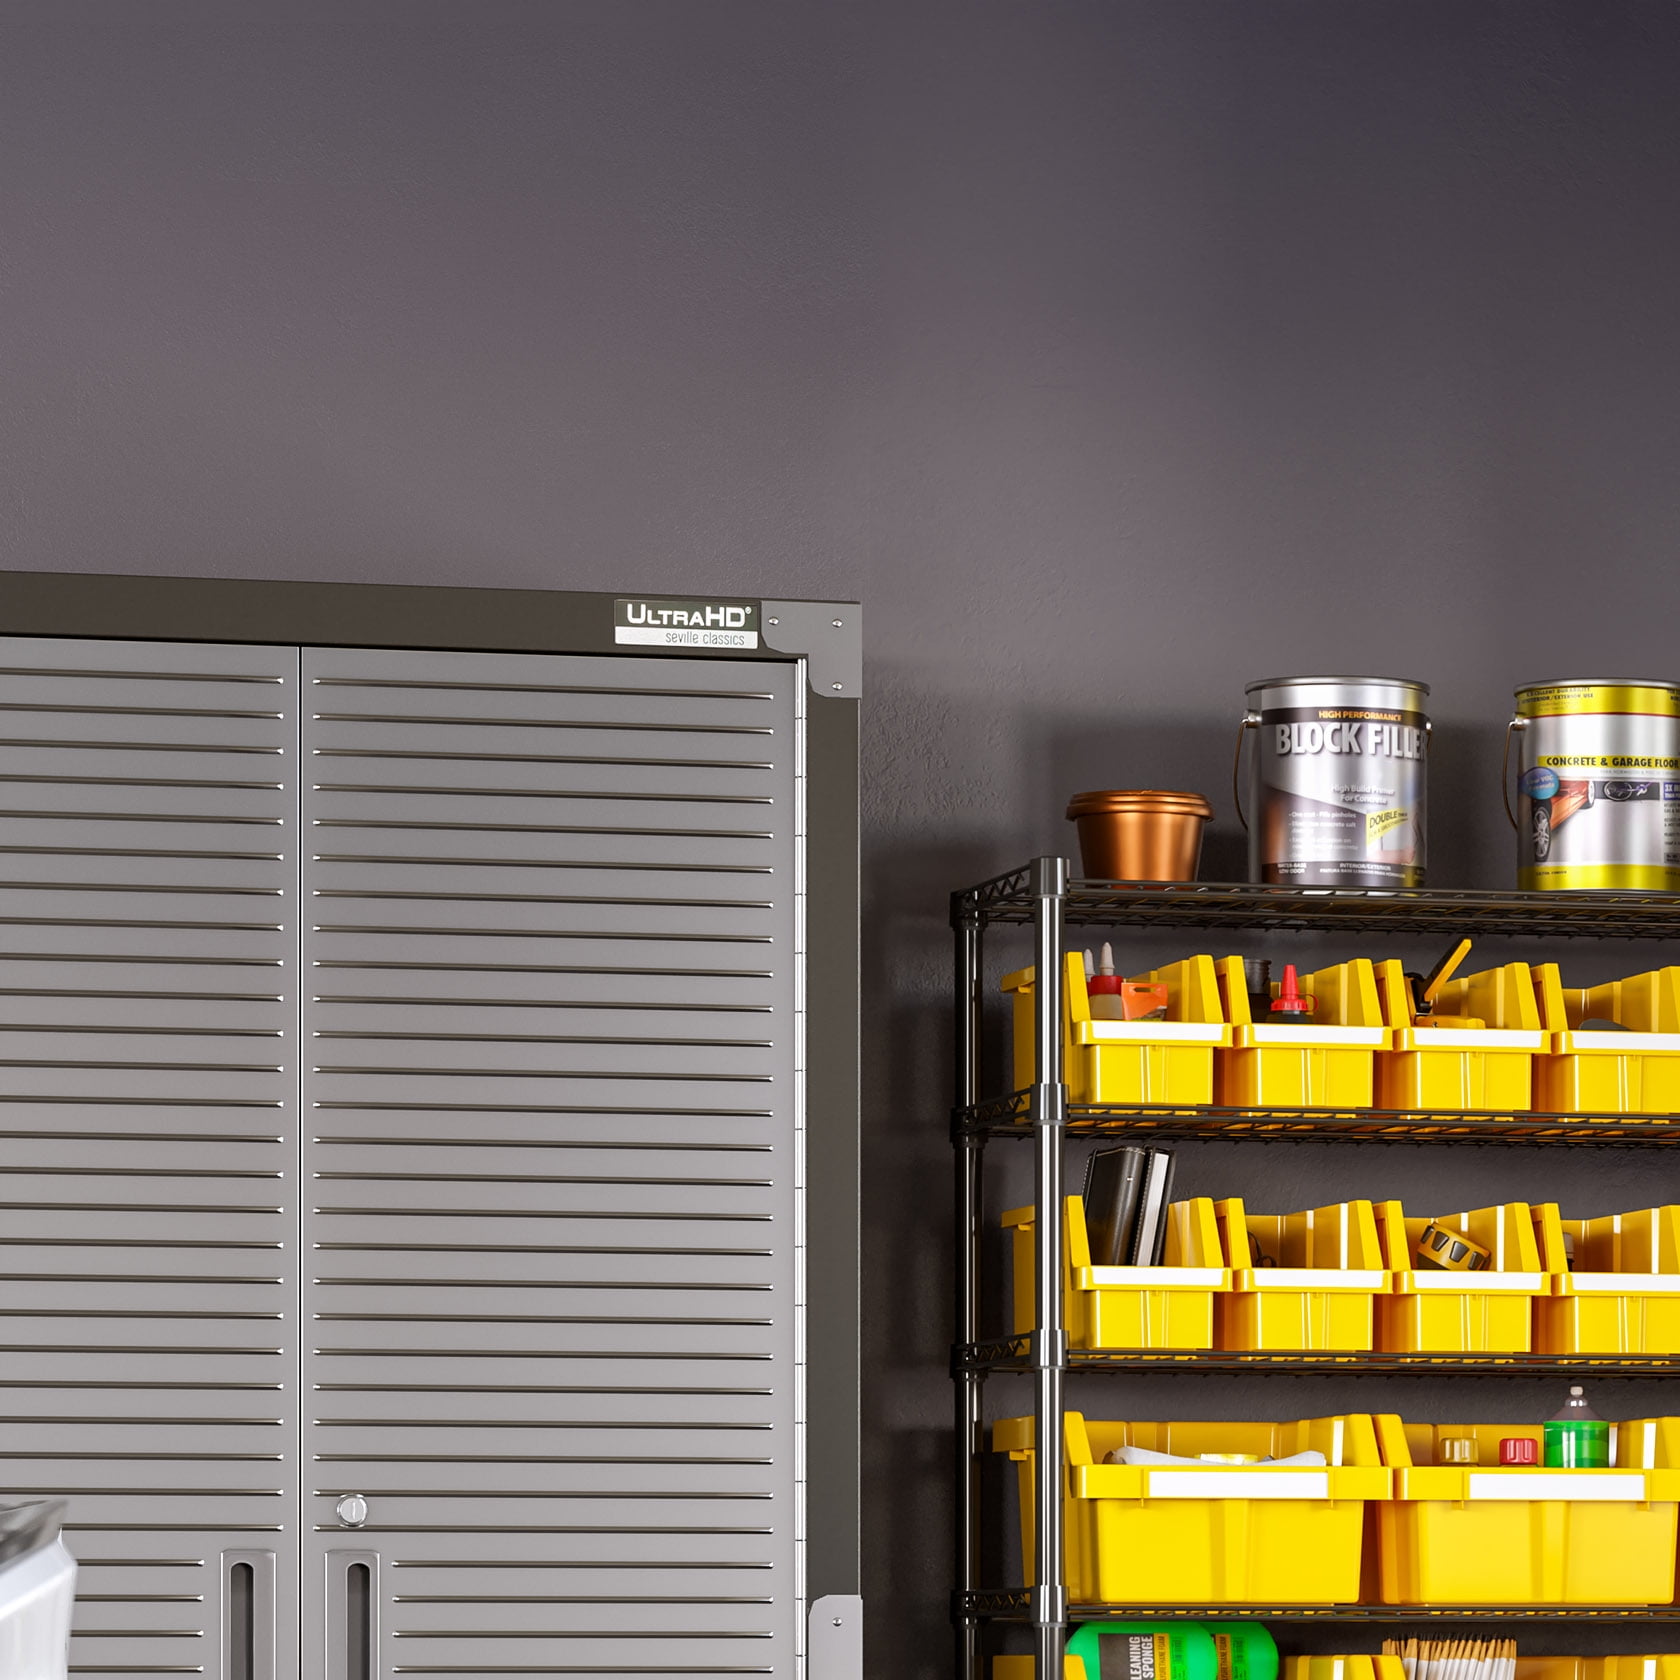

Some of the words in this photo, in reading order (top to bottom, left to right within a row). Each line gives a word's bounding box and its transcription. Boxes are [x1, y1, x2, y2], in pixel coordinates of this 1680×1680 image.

[665, 631, 699, 645] seville
[702, 632, 745, 647] classics
[1318, 710, 1342, 719] HIGH
[1343, 711, 1402, 721] PERFORMANCE
[1275, 722, 1361, 755] BLOCK
[1546, 757, 1596, 766] CONCRETE
[1600, 757, 1609, 766] &
[1612, 757, 1652, 767] GARAGE
[1654, 758, 1679, 768] FLOOR
[1369, 810, 1399, 829] DOUBLE
[1141, 1636, 1154, 1679] SPONGE
